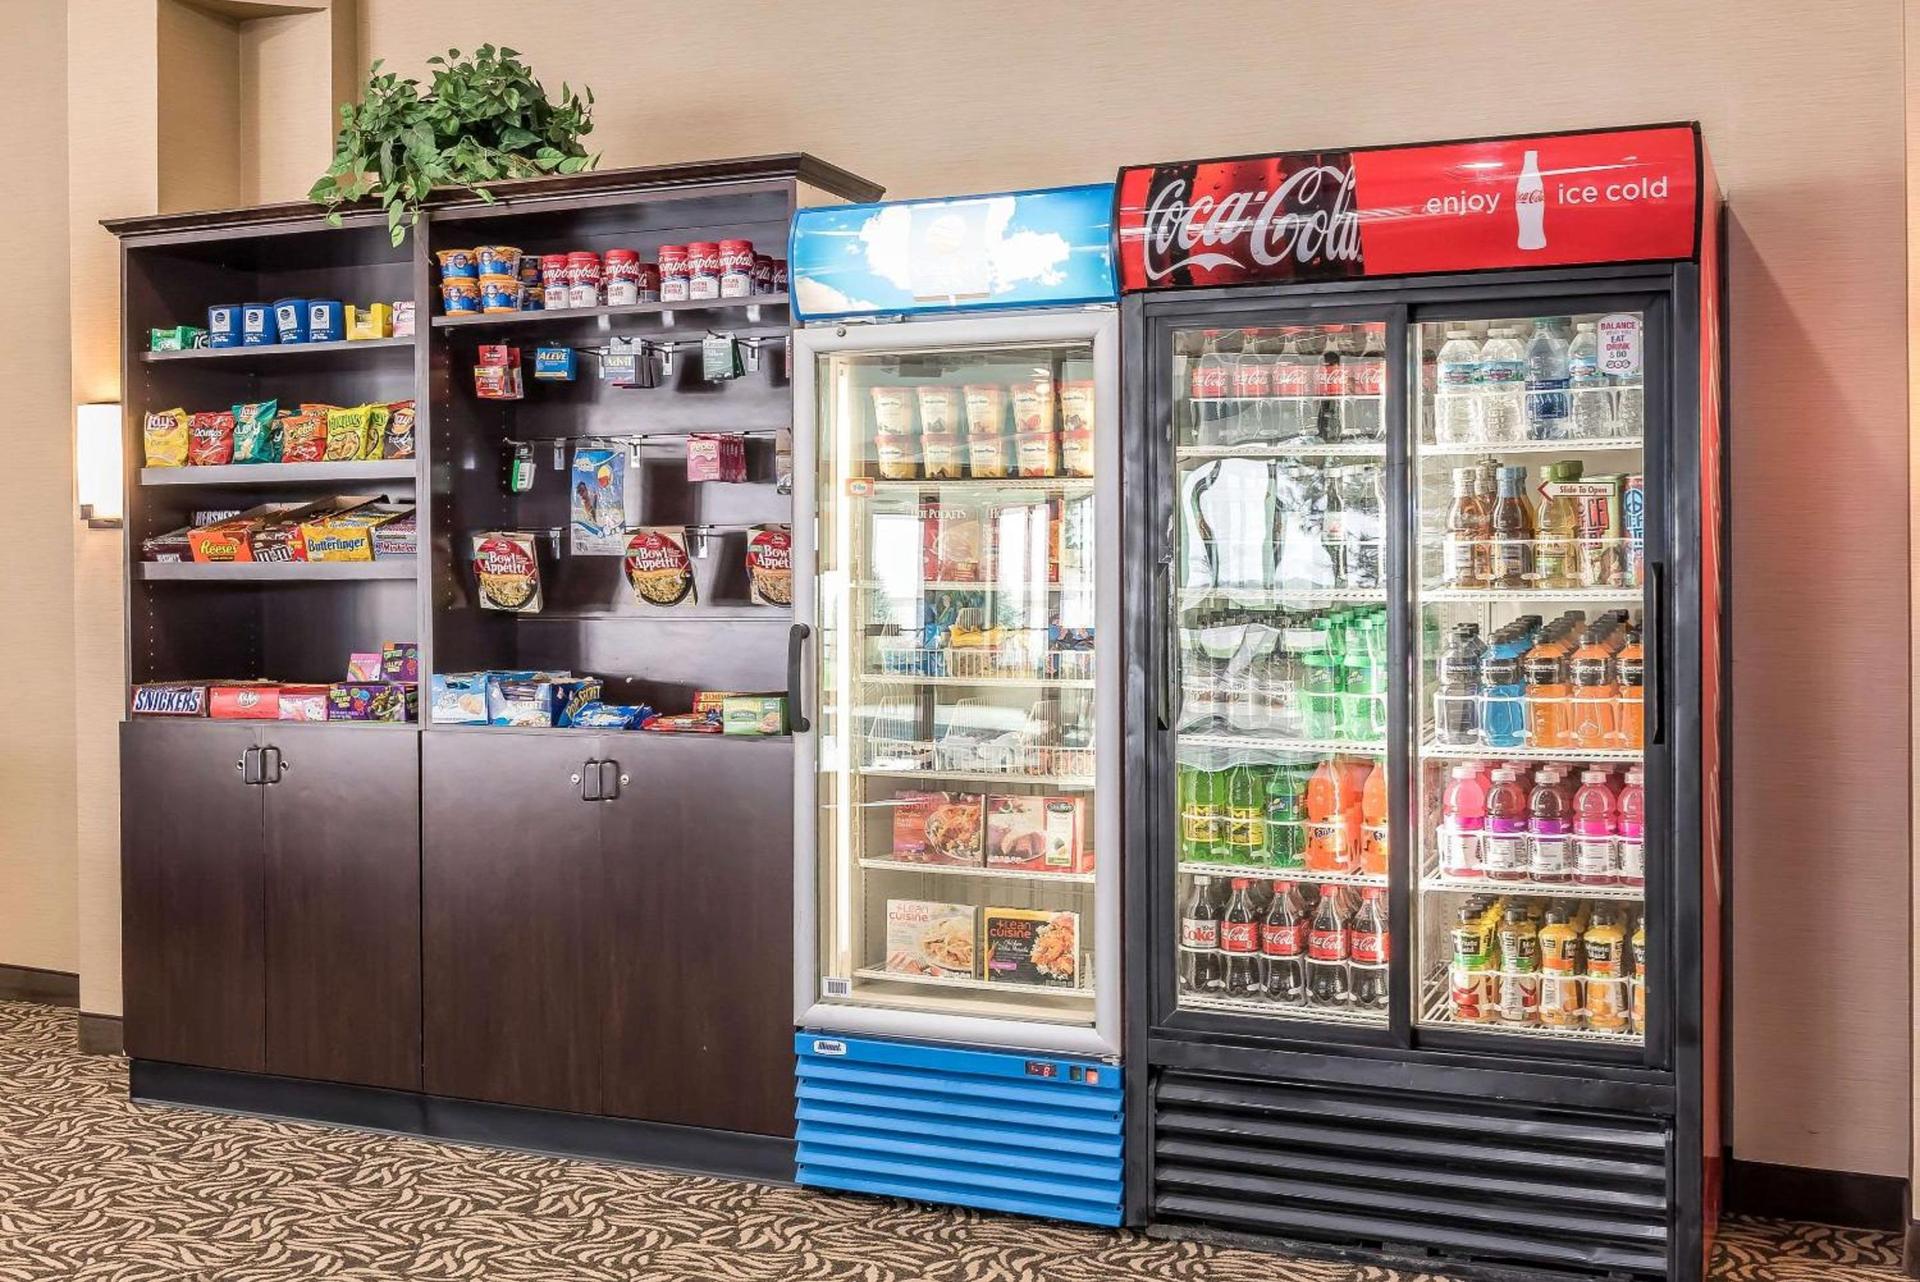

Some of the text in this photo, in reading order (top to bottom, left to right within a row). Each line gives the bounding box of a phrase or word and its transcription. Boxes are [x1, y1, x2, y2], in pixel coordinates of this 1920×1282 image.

[1557, 176, 1668, 204] ice cold
[1426, 190, 1501, 219] enjoy
[1143, 165, 1363, 280] Coca-Cola
[1600, 321, 1637, 330] BALANCE
[1610, 334, 1625, 343] EAT
[1606, 343, 1631, 351] DRINK
[1616, 350, 1627, 358] DO
[606, 357, 632, 367] Advil
[1559, 485, 1608, 495] Slide To Open
[200, 540, 238, 555] Reese's
[307, 537, 365, 552] Butterfinger
[489, 551, 516, 563] Bowl
[640, 547, 668, 560] Bowl
[135, 689, 200, 712] SNICKERS
[889, 911, 928, 922] cuisine
[989, 928, 1032, 940] cuisine
